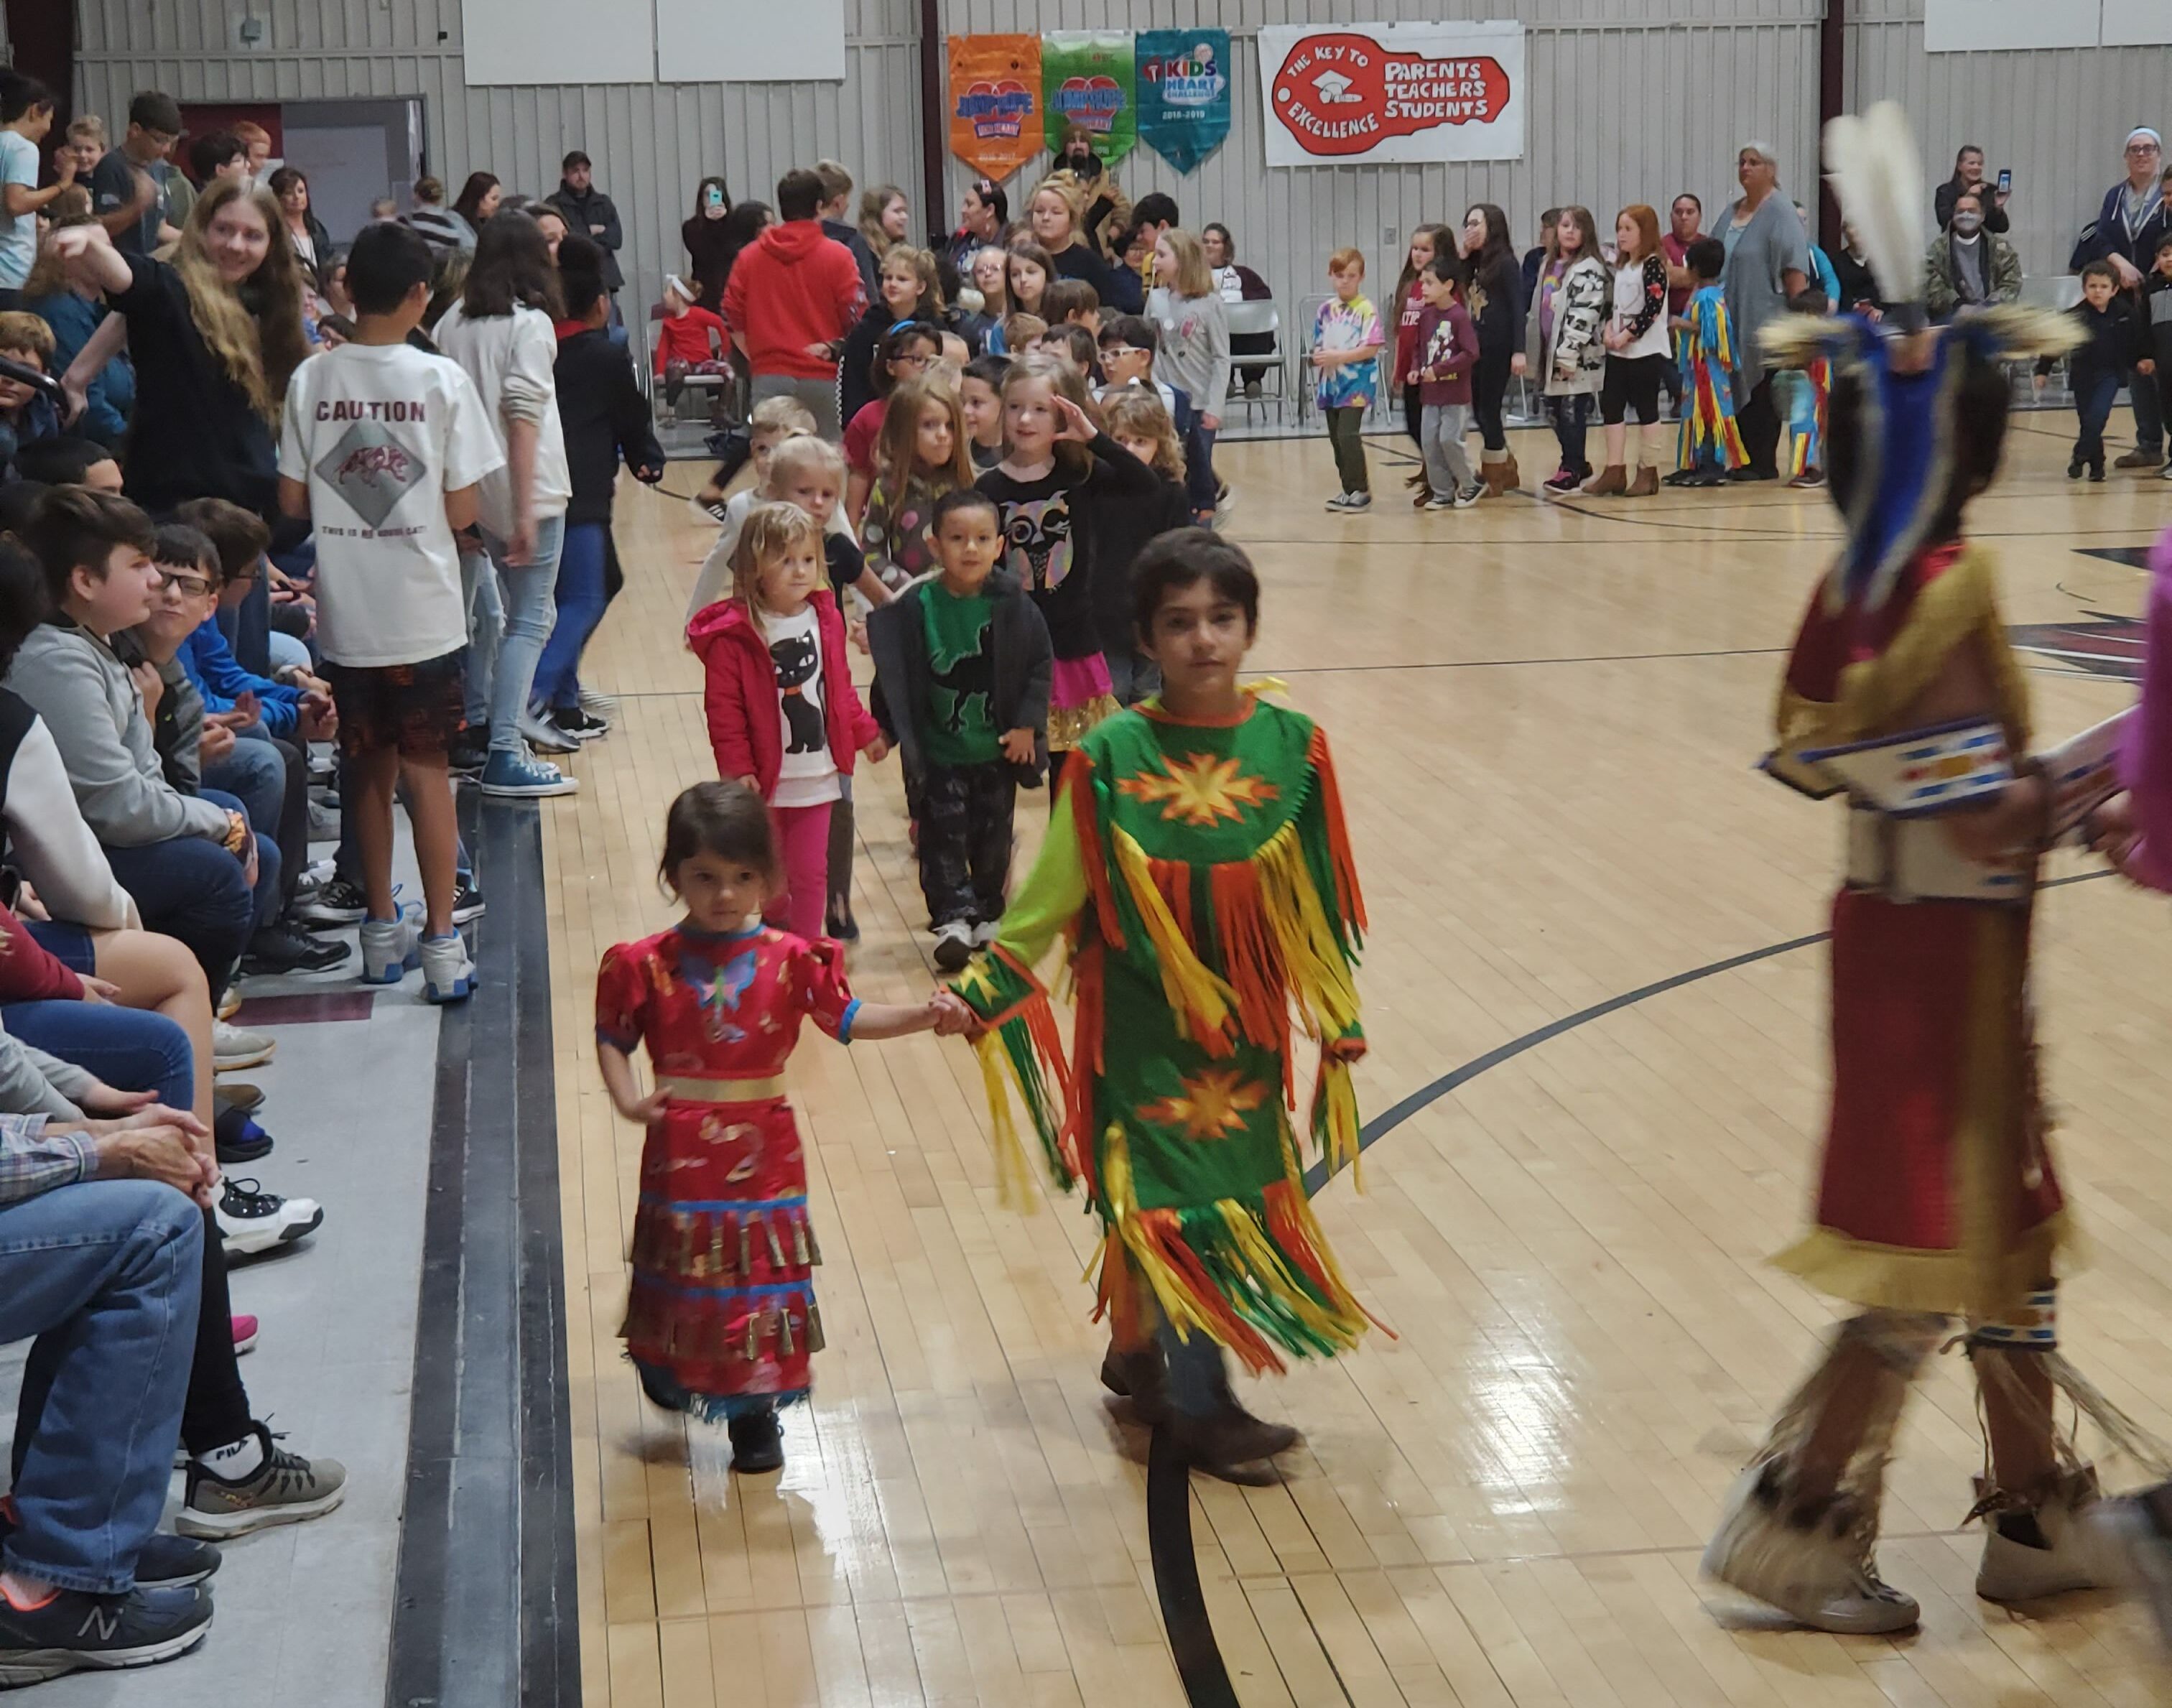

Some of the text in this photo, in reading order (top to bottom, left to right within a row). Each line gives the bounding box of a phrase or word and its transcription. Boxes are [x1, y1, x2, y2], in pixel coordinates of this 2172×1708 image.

[1166, 60, 1217, 78] KIDS
[1287, 45, 1368, 77] THE KEY TO
[1385, 62, 1480, 81] PARENTS
[1166, 78, 1217, 90] HEART
[1384, 80, 1486, 99] TEACHERS
[1384, 99, 1488, 119] STUDENTS
[1287, 101, 1379, 139] EXCELLENCE
[316, 401, 425, 422] CAUTION
[216, 1439, 248, 1461] FILA
